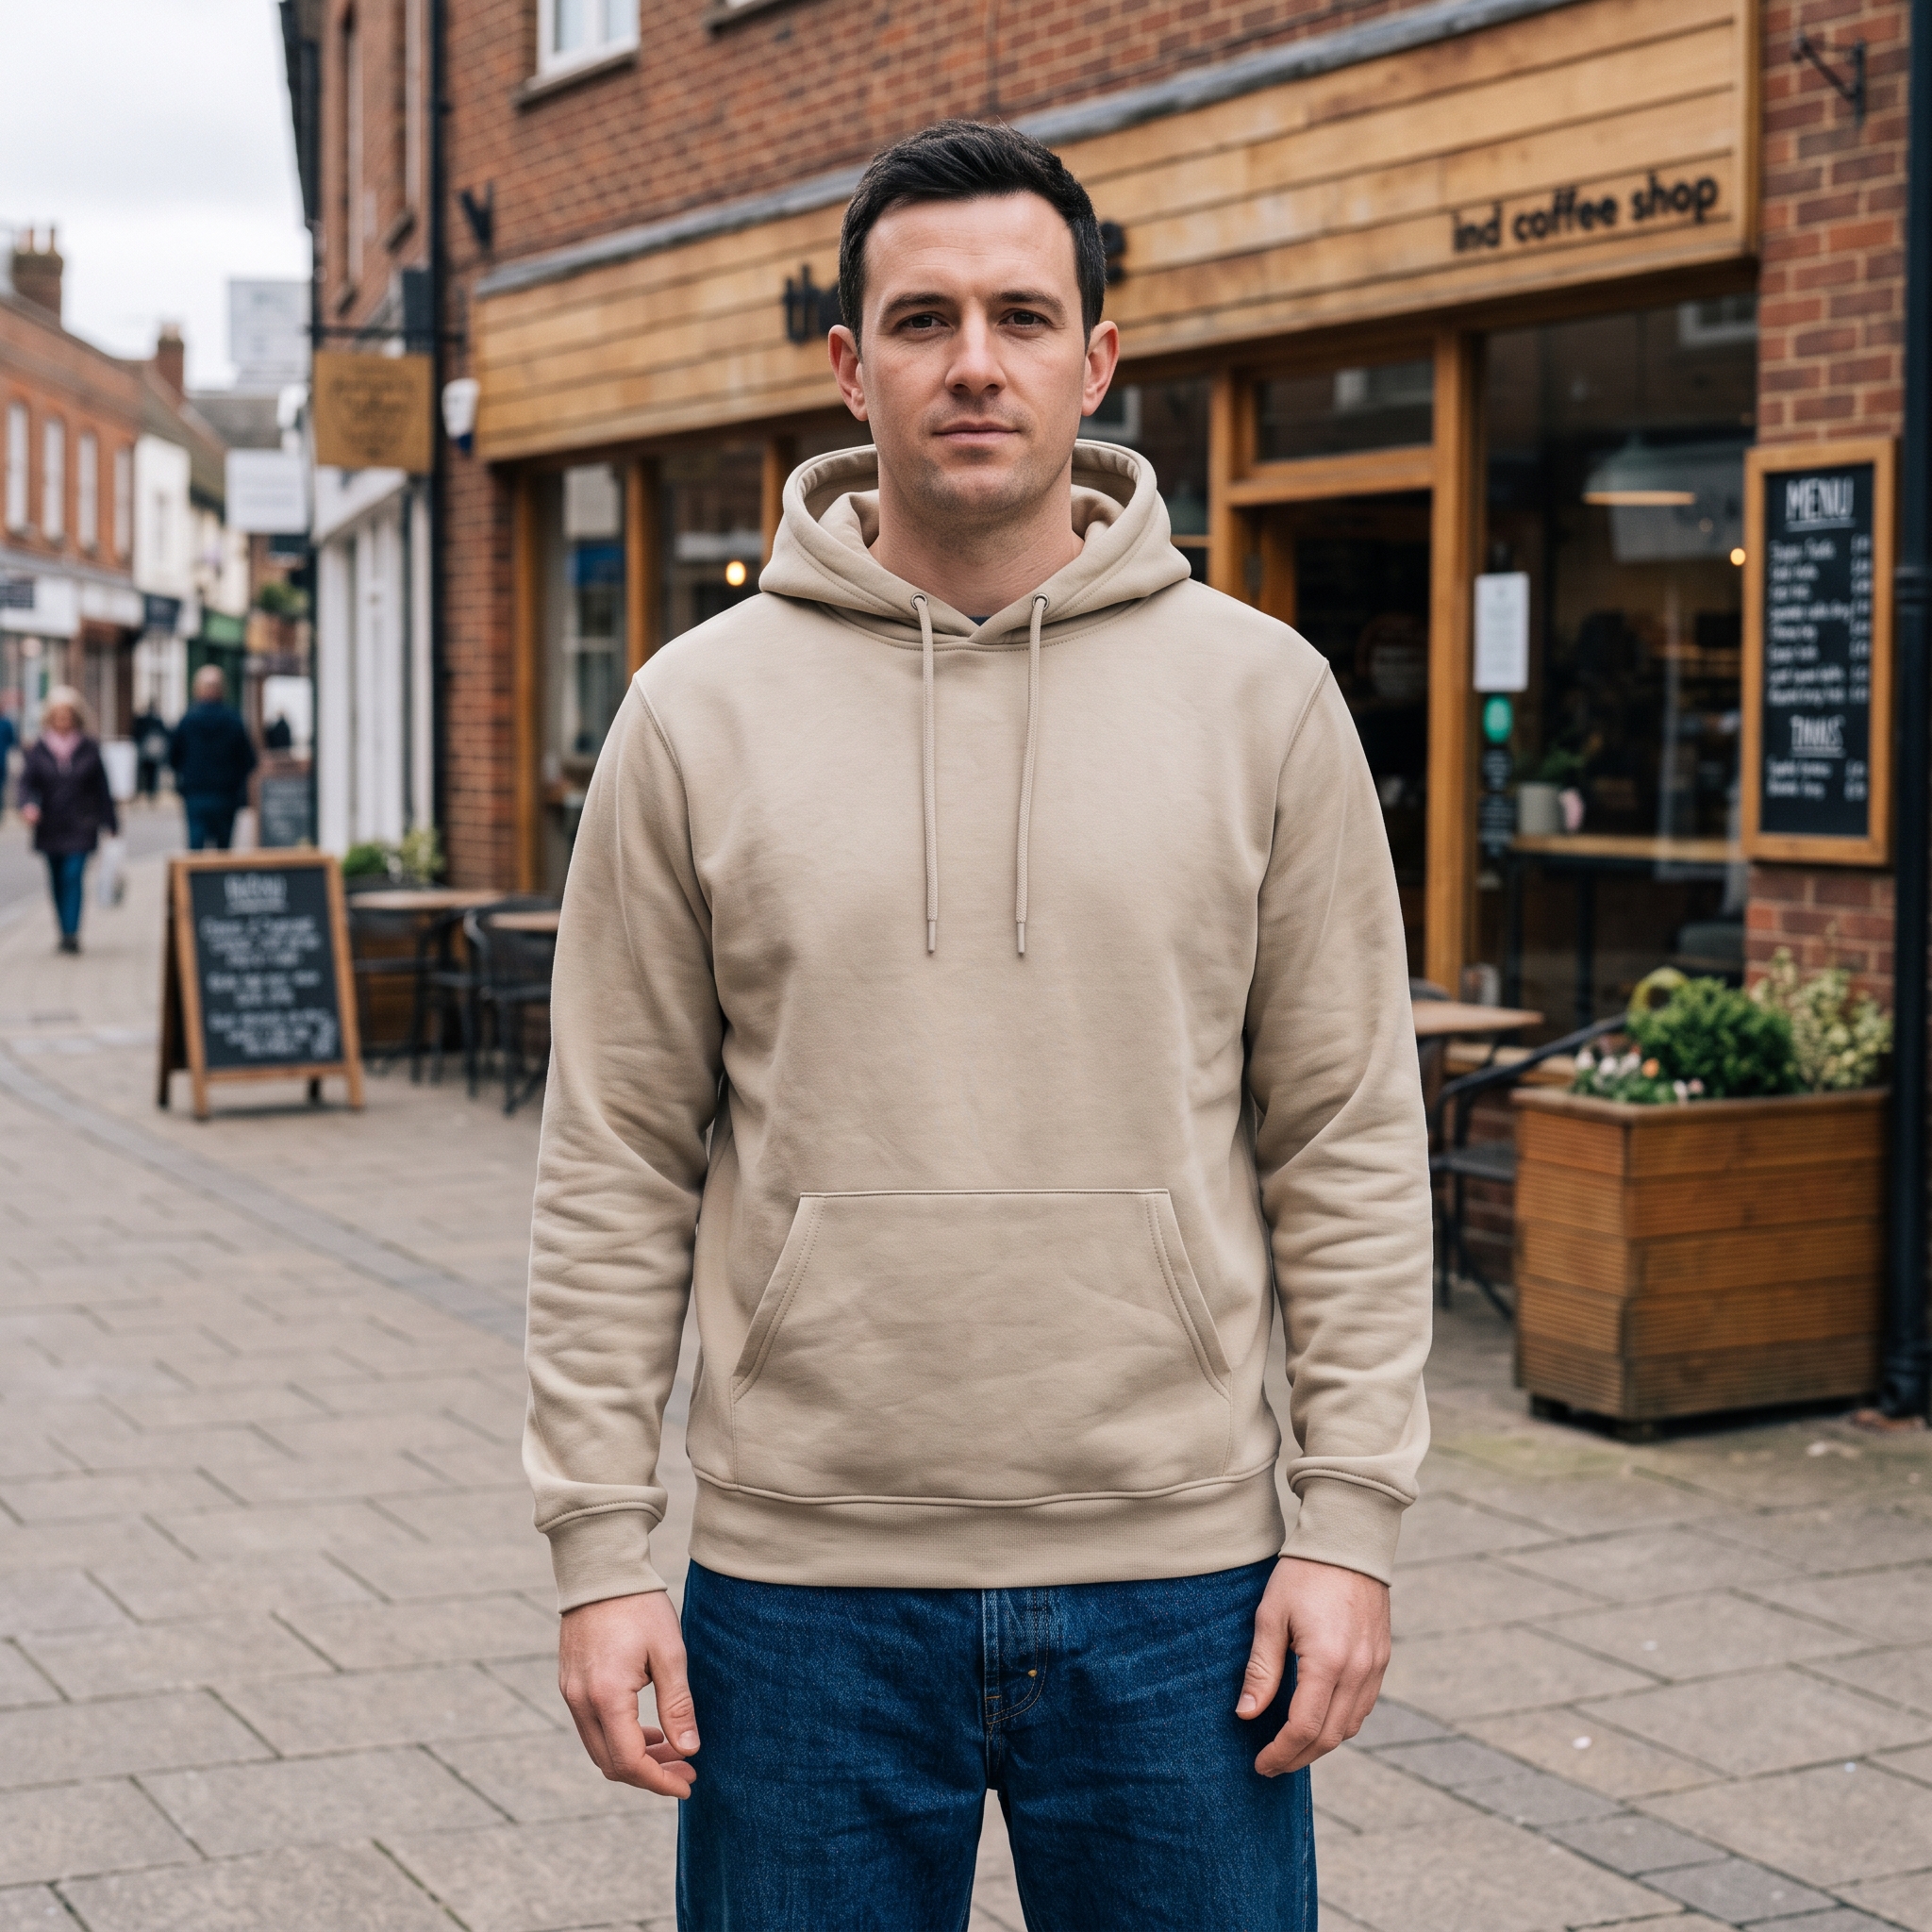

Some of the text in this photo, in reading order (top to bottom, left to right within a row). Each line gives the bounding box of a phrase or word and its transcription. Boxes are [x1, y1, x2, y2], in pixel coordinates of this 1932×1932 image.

[1512, 184, 1618, 243] coffee
[1631, 168, 1719, 225] shop
[1785, 476, 1854, 521] MENU
